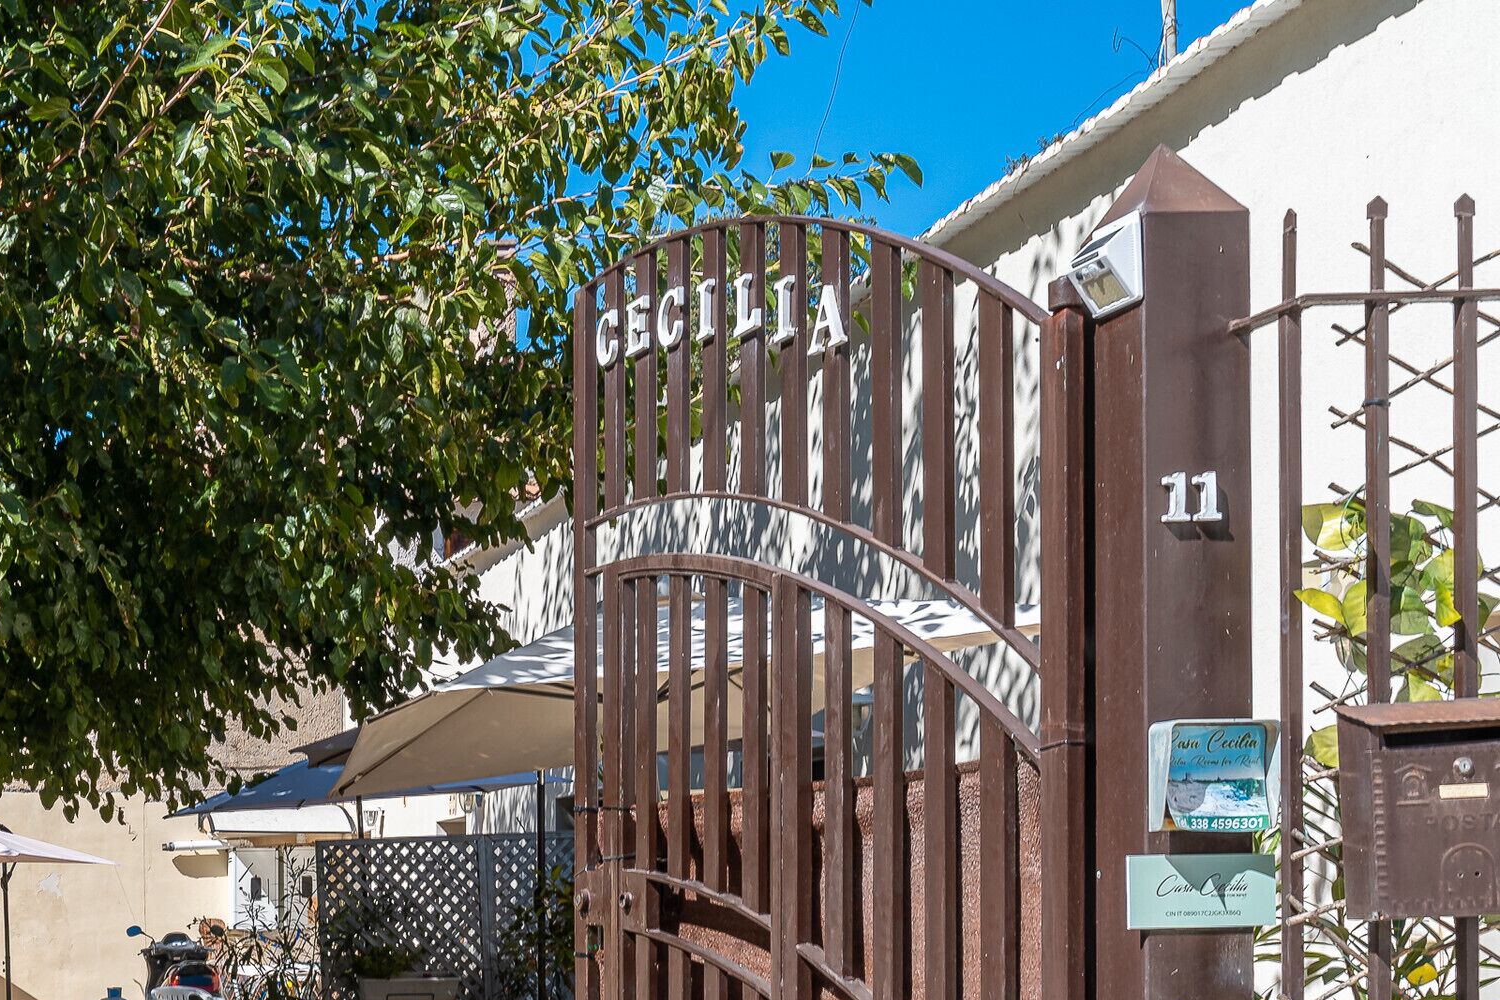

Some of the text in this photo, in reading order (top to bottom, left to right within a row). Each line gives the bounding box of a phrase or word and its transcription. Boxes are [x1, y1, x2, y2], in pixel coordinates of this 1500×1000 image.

[595, 272, 848, 368] CECILIA
[1161, 471, 1223, 522] 11
[1206, 729, 1258, 753] Cecilia
[1191, 818, 1209, 829] 338
[1211, 817, 1263, 830] 4596301
[1156, 872, 1248, 897] Casa Cecilia
